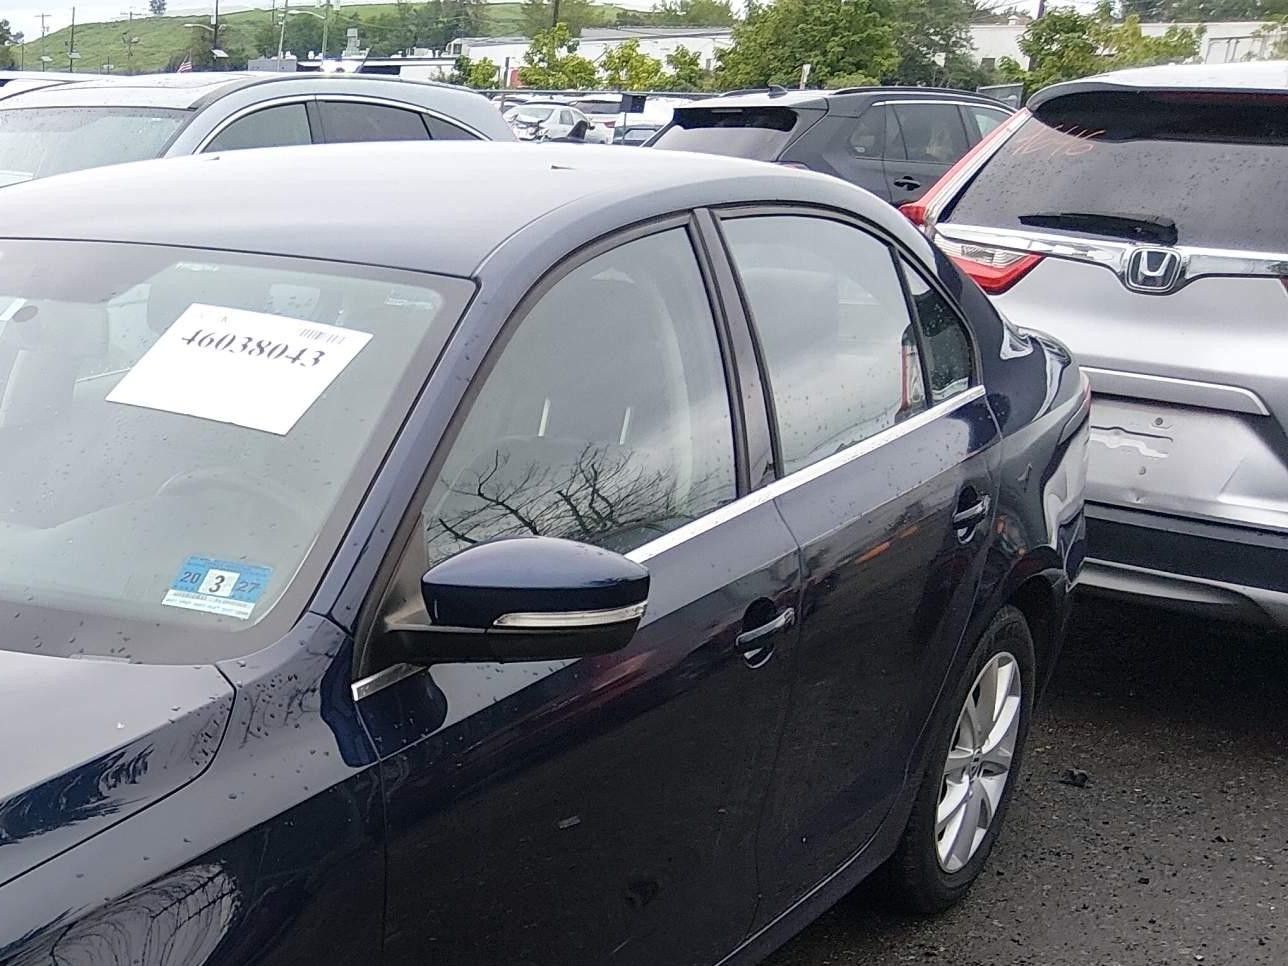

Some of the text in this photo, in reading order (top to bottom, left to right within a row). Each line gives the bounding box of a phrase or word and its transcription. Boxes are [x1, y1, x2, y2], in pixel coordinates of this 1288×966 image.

[181, 329, 326, 368] 46038043
[179, 571, 202, 585] 20
[208, 575, 225, 593] 3
